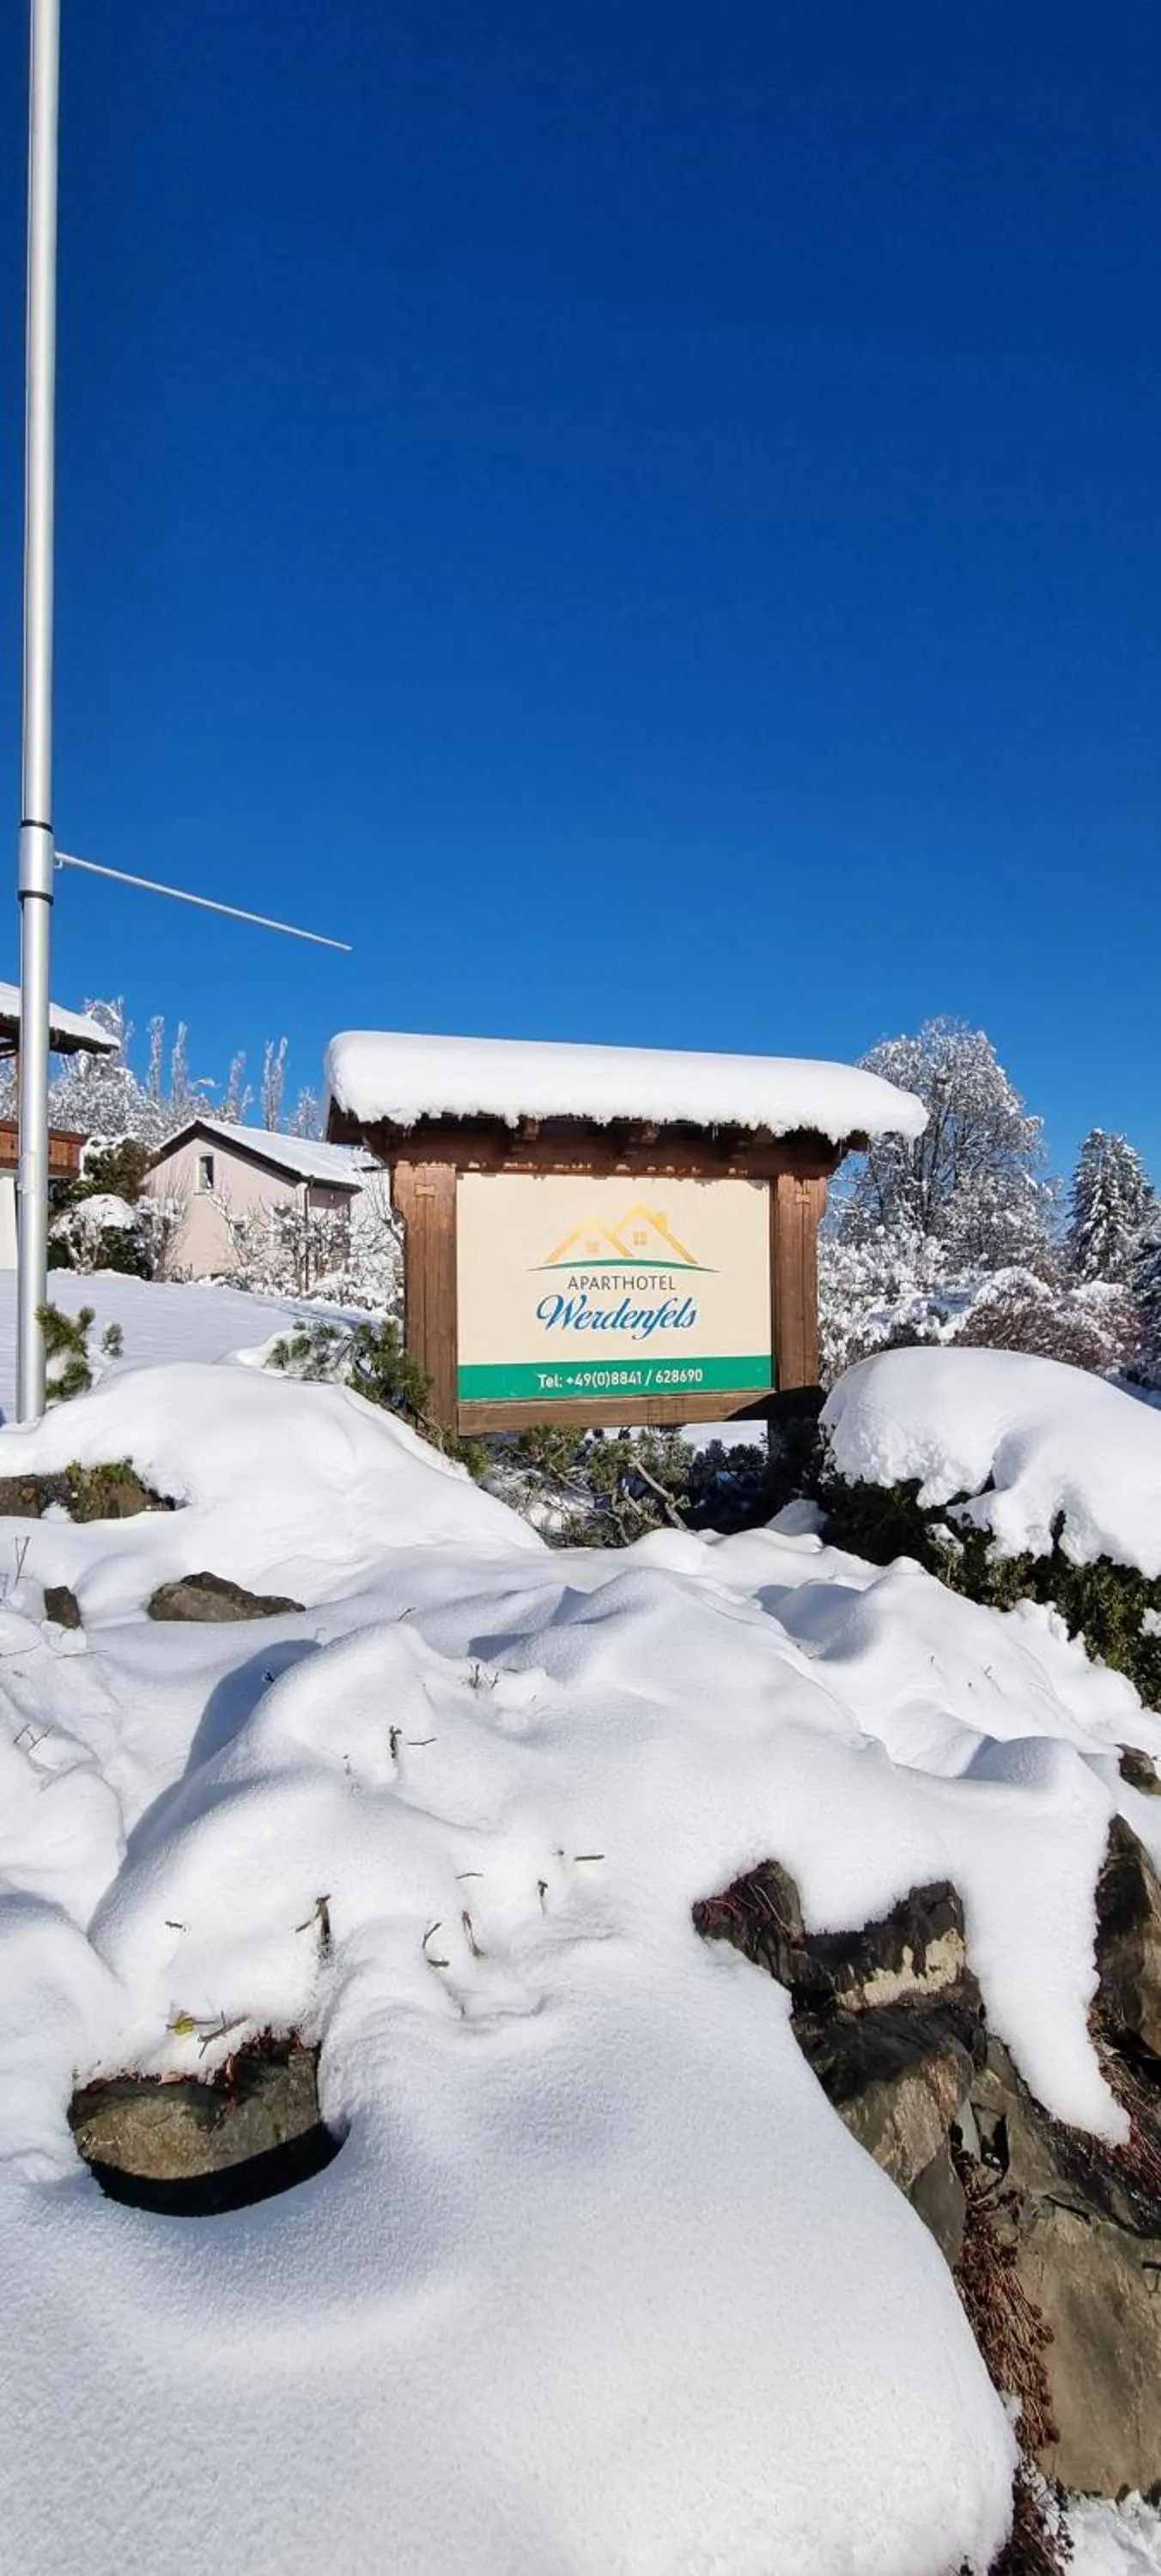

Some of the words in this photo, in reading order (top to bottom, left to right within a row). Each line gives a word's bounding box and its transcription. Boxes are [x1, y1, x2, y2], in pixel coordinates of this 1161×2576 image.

[568, 1275, 677, 1291] APARTHOTEL
[536, 1293, 697, 1340] Werdenfels
[538, 1373, 562, 1388] Tel:
[566, 1370, 642, 1388] +49(0)8841
[644, 1369, 653, 1387] /
[655, 1369, 703, 1384] 628690
